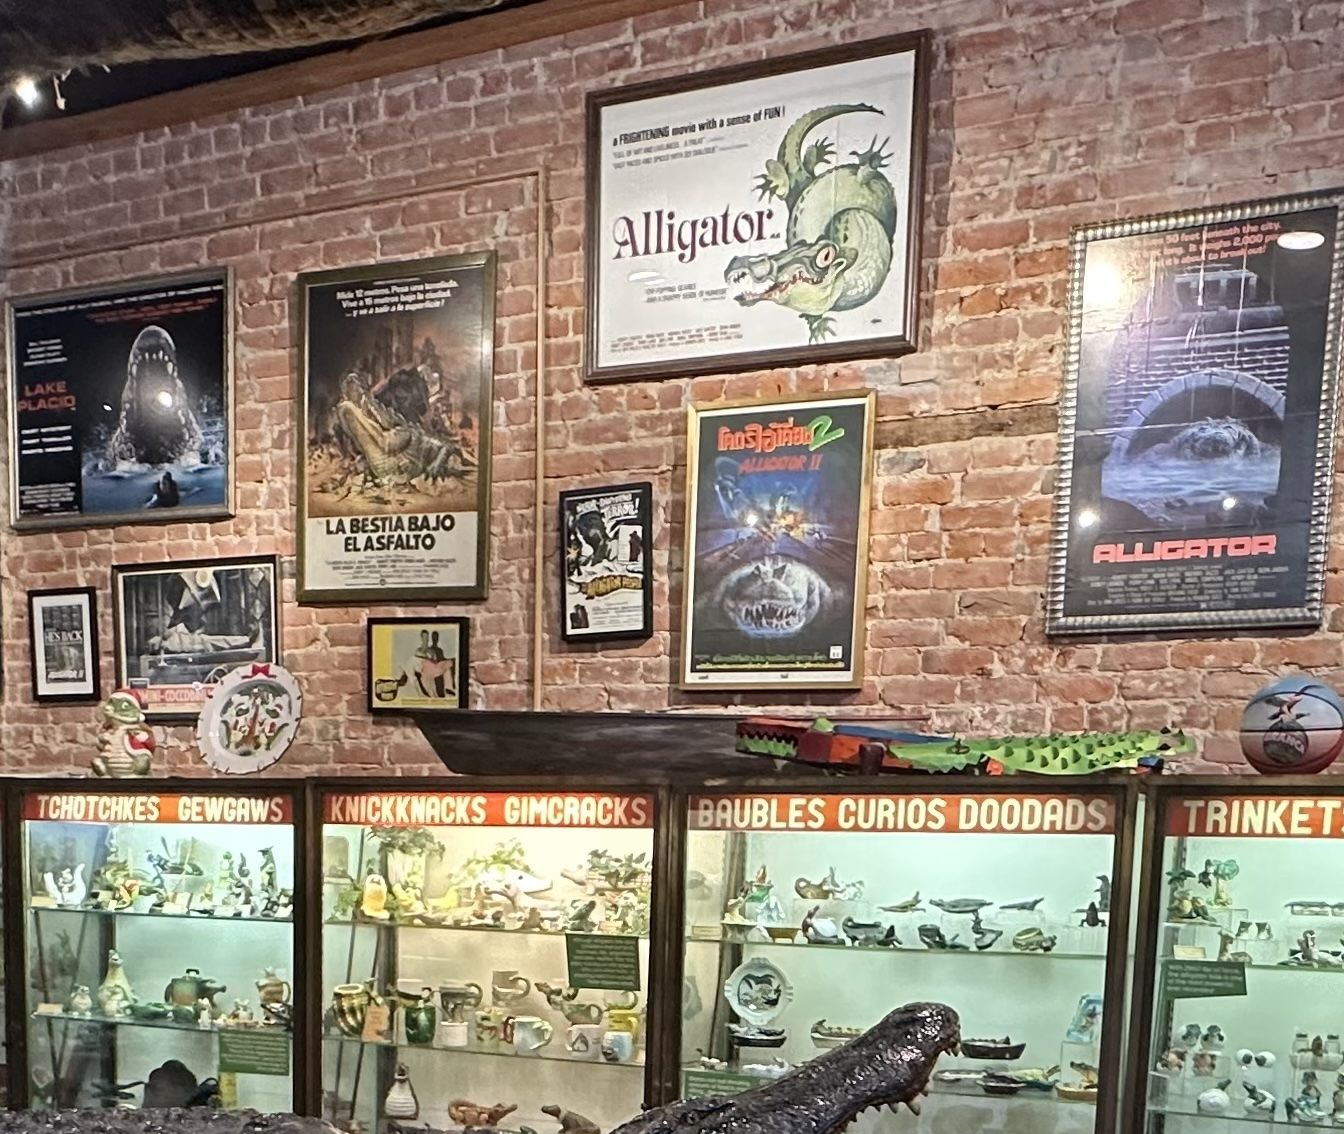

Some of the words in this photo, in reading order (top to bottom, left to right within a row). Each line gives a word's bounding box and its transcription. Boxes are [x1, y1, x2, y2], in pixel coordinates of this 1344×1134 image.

[619, 126, 670, 145] FRIGHTENING
[671, 122, 696, 137] movie
[698, 118, 717, 132] with
[719, 118, 724, 128] a
[726, 114, 751, 127] sense
[752, 110, 762, 122] of
[611, 203, 774, 264] Alligator
[17, 395, 76, 412] PLACID
[24, 380, 68, 397] LAKE
[738, 454, 808, 474] ALLIGATOR
[325, 517, 347, 535] LA
[349, 515, 406, 534] BESTIA
[407, 513, 456, 532] BAJO
[344, 536, 362, 553] EL
[362, 532, 436, 552] ASFALTO
[1092, 534, 1278, 564] ALLIGATOR
[37, 794, 160, 822] TCHOTCHKES
[177, 796, 284, 824] GEWGAWS
[330, 795, 487, 825] KNICKKNACKS
[503, 795, 648, 827] GIMCRACKS
[696, 797, 827, 830] BAUBLES
[836, 797, 948, 830] CURIOS
[958, 798, 1108, 831] DOODADS
